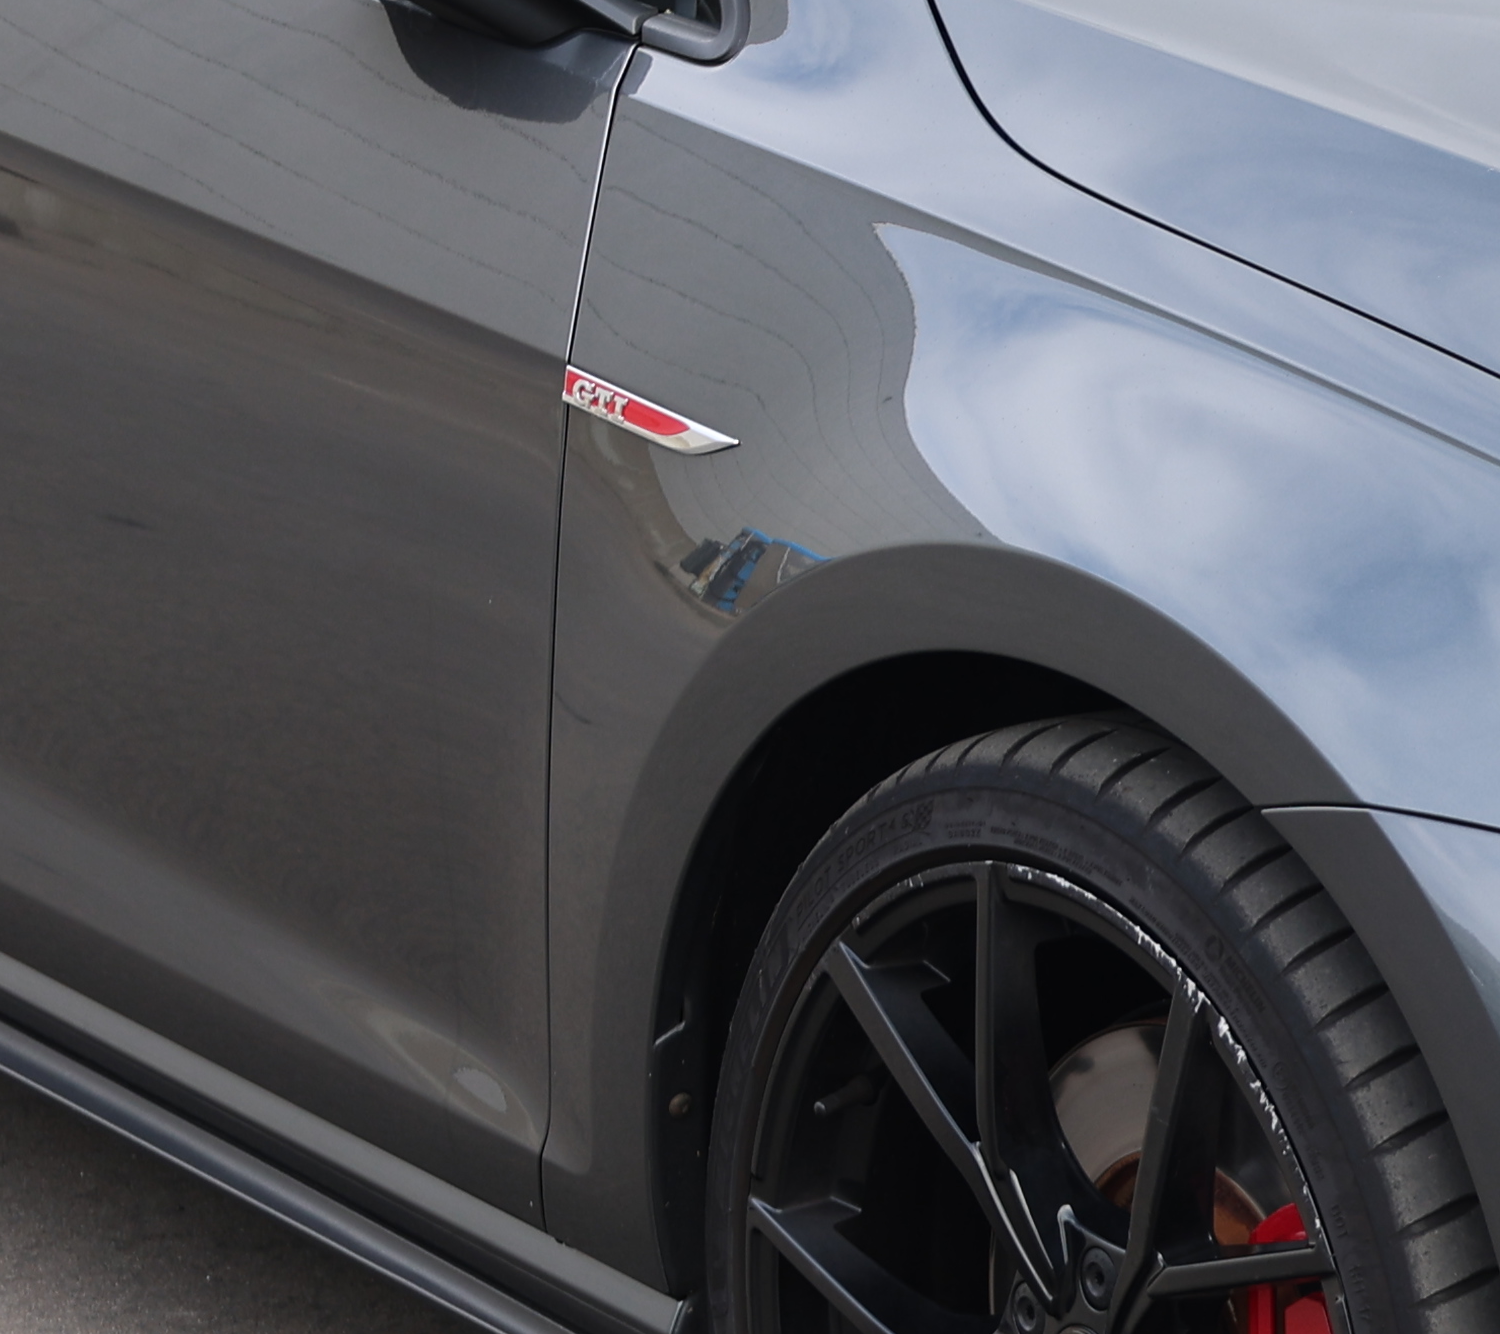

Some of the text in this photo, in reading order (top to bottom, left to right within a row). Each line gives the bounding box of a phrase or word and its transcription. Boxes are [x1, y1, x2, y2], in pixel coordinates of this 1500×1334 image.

[572, 378, 629, 424] GTI
[794, 867, 832, 918] PILOT
[837, 820, 888, 872] SPORT
